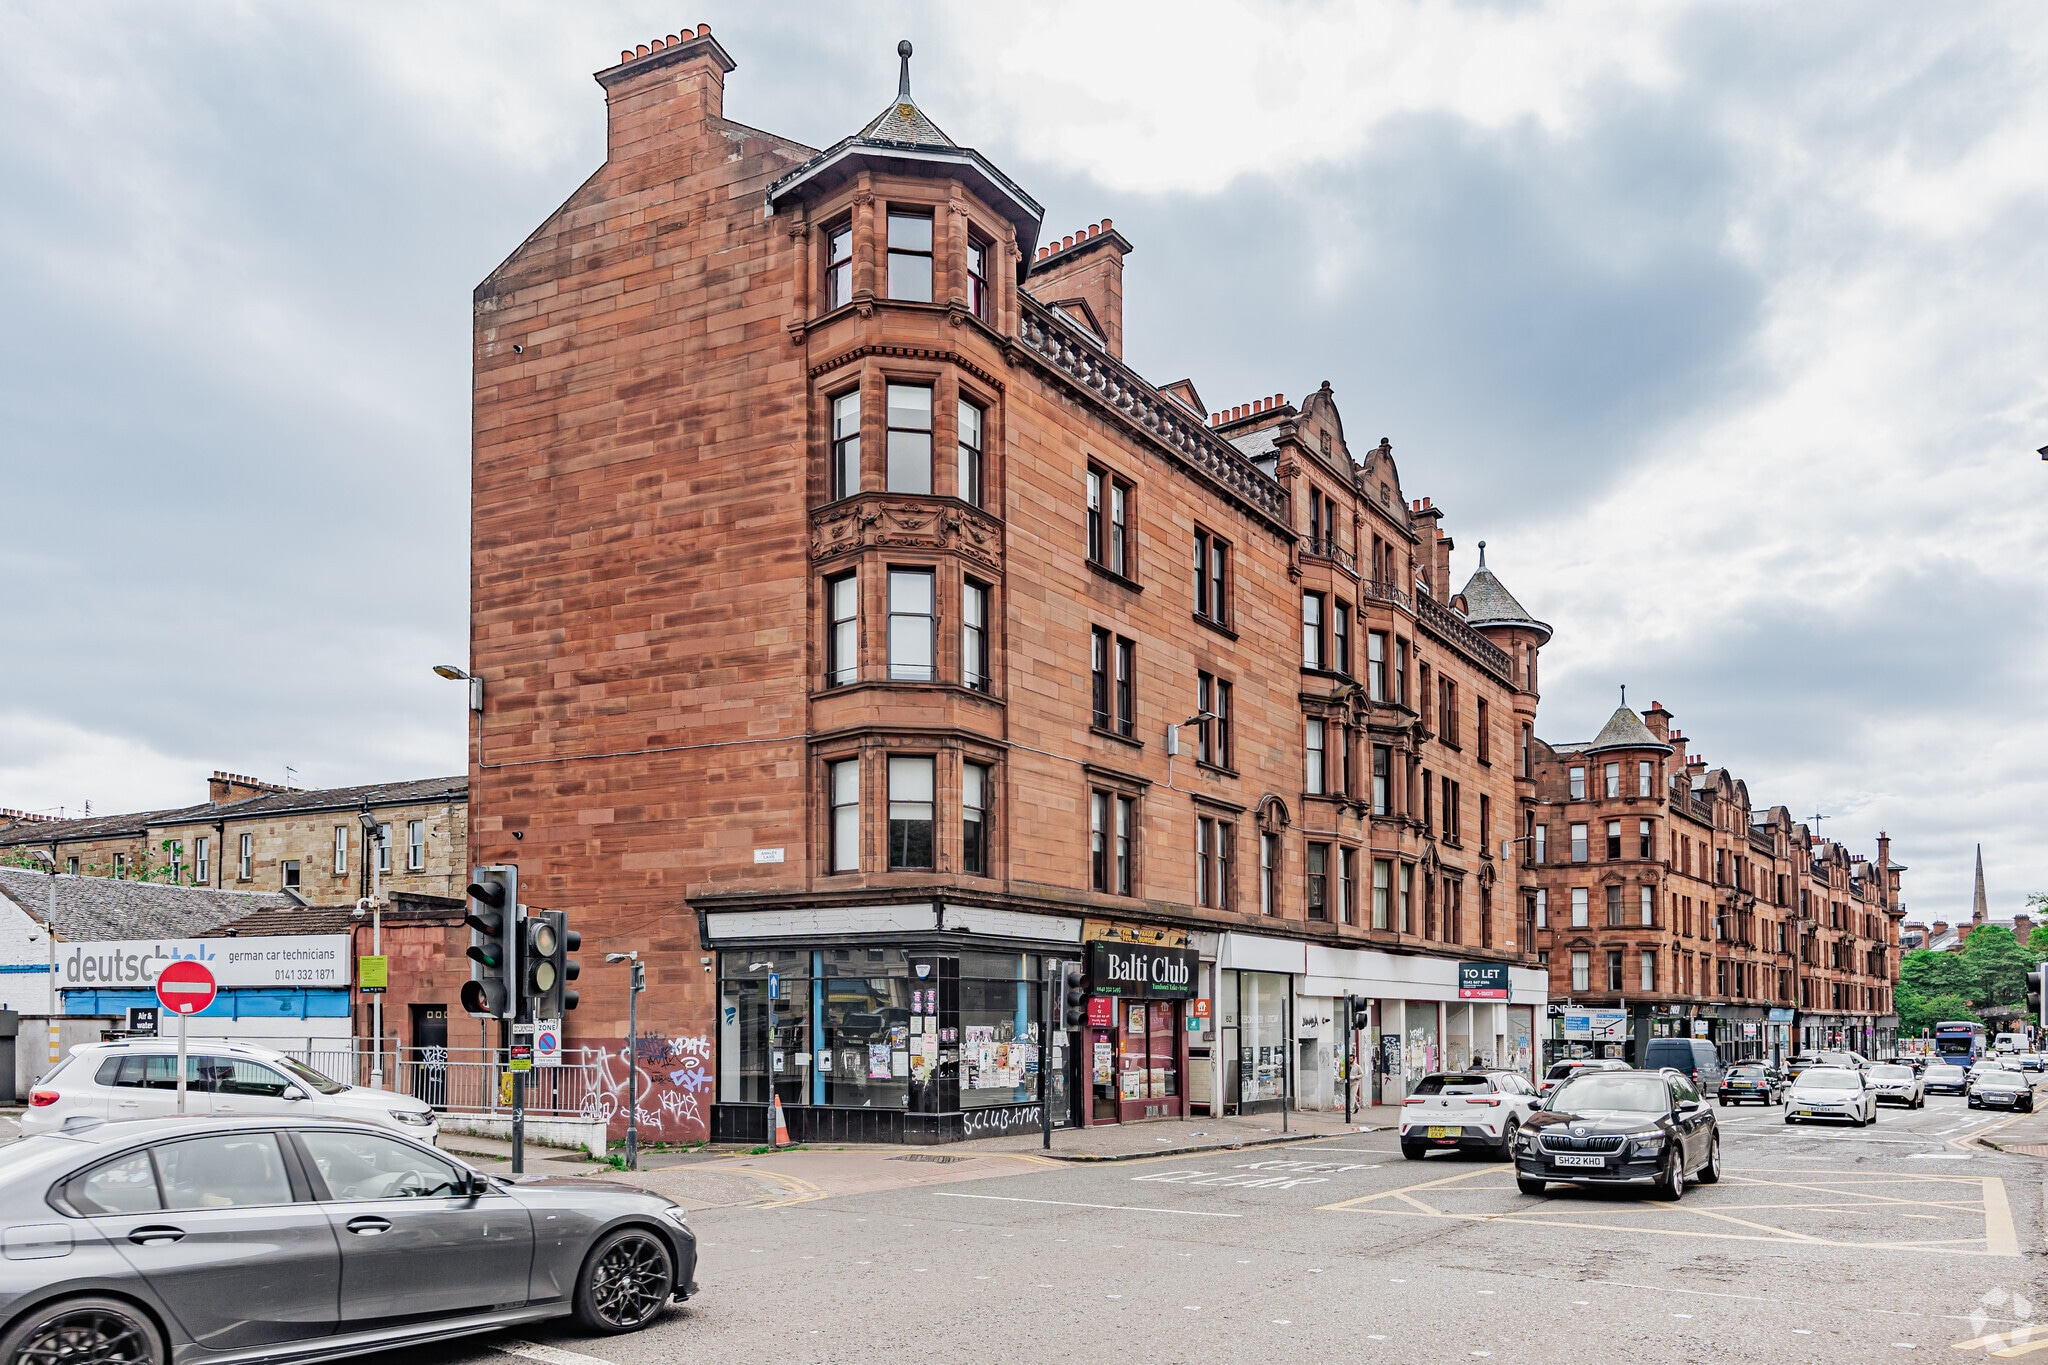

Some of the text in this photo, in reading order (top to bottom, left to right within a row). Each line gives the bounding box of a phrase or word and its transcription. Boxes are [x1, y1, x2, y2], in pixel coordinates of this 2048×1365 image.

[229, 948, 335, 964] german car technicians
[274, 968, 335, 981] 0141 332 1871
[1107, 953, 1189, 985] Balti Club
[1463, 969, 1500, 979] TO LET
[137, 1011, 153, 1020] Air &
[1558, 1156, 1601, 1166] SH22 KHO
[1130, 1170, 1329, 1190] CLEAR
